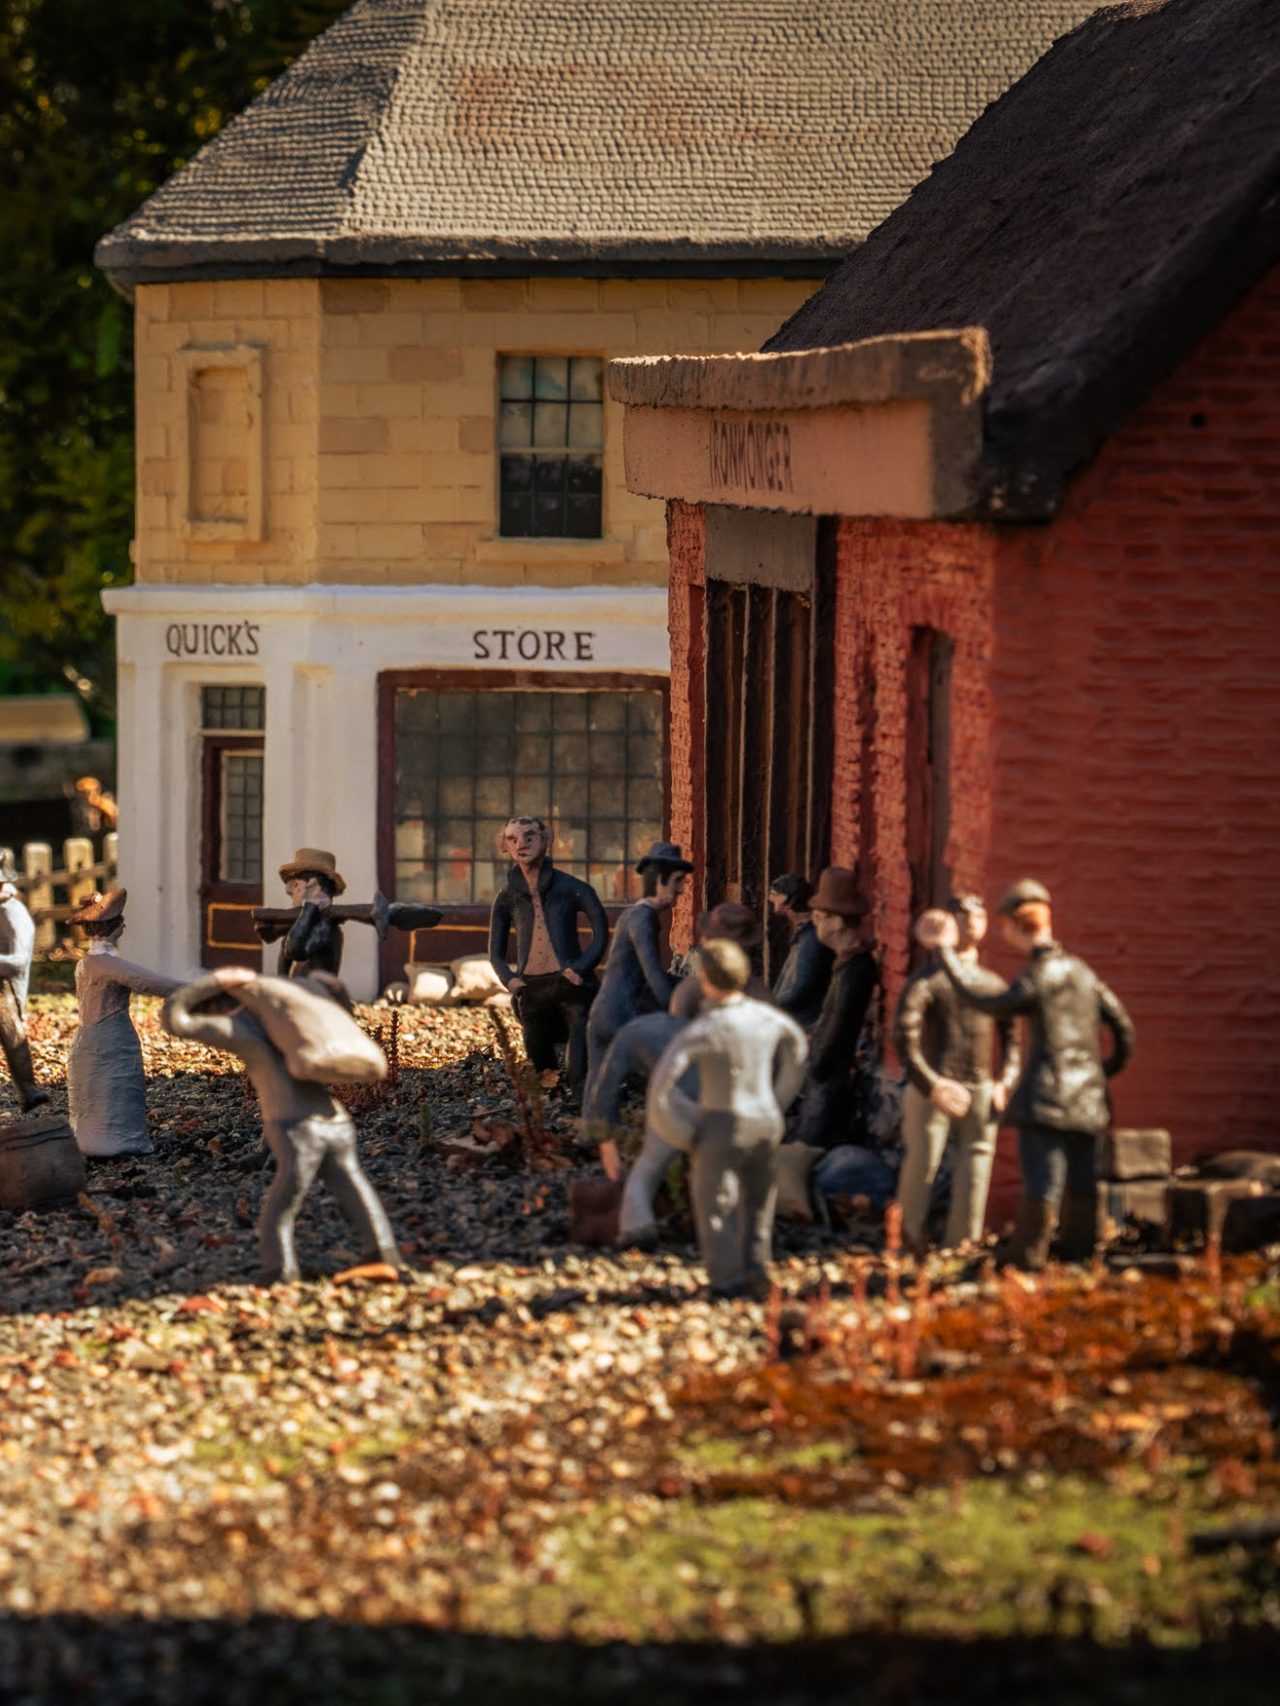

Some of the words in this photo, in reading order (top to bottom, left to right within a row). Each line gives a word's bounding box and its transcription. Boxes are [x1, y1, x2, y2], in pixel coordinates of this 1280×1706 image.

[708, 420, 794, 494] IRONMONGER
[166, 620, 260, 658] QUICK'S
[473, 630, 594, 660] STORE
